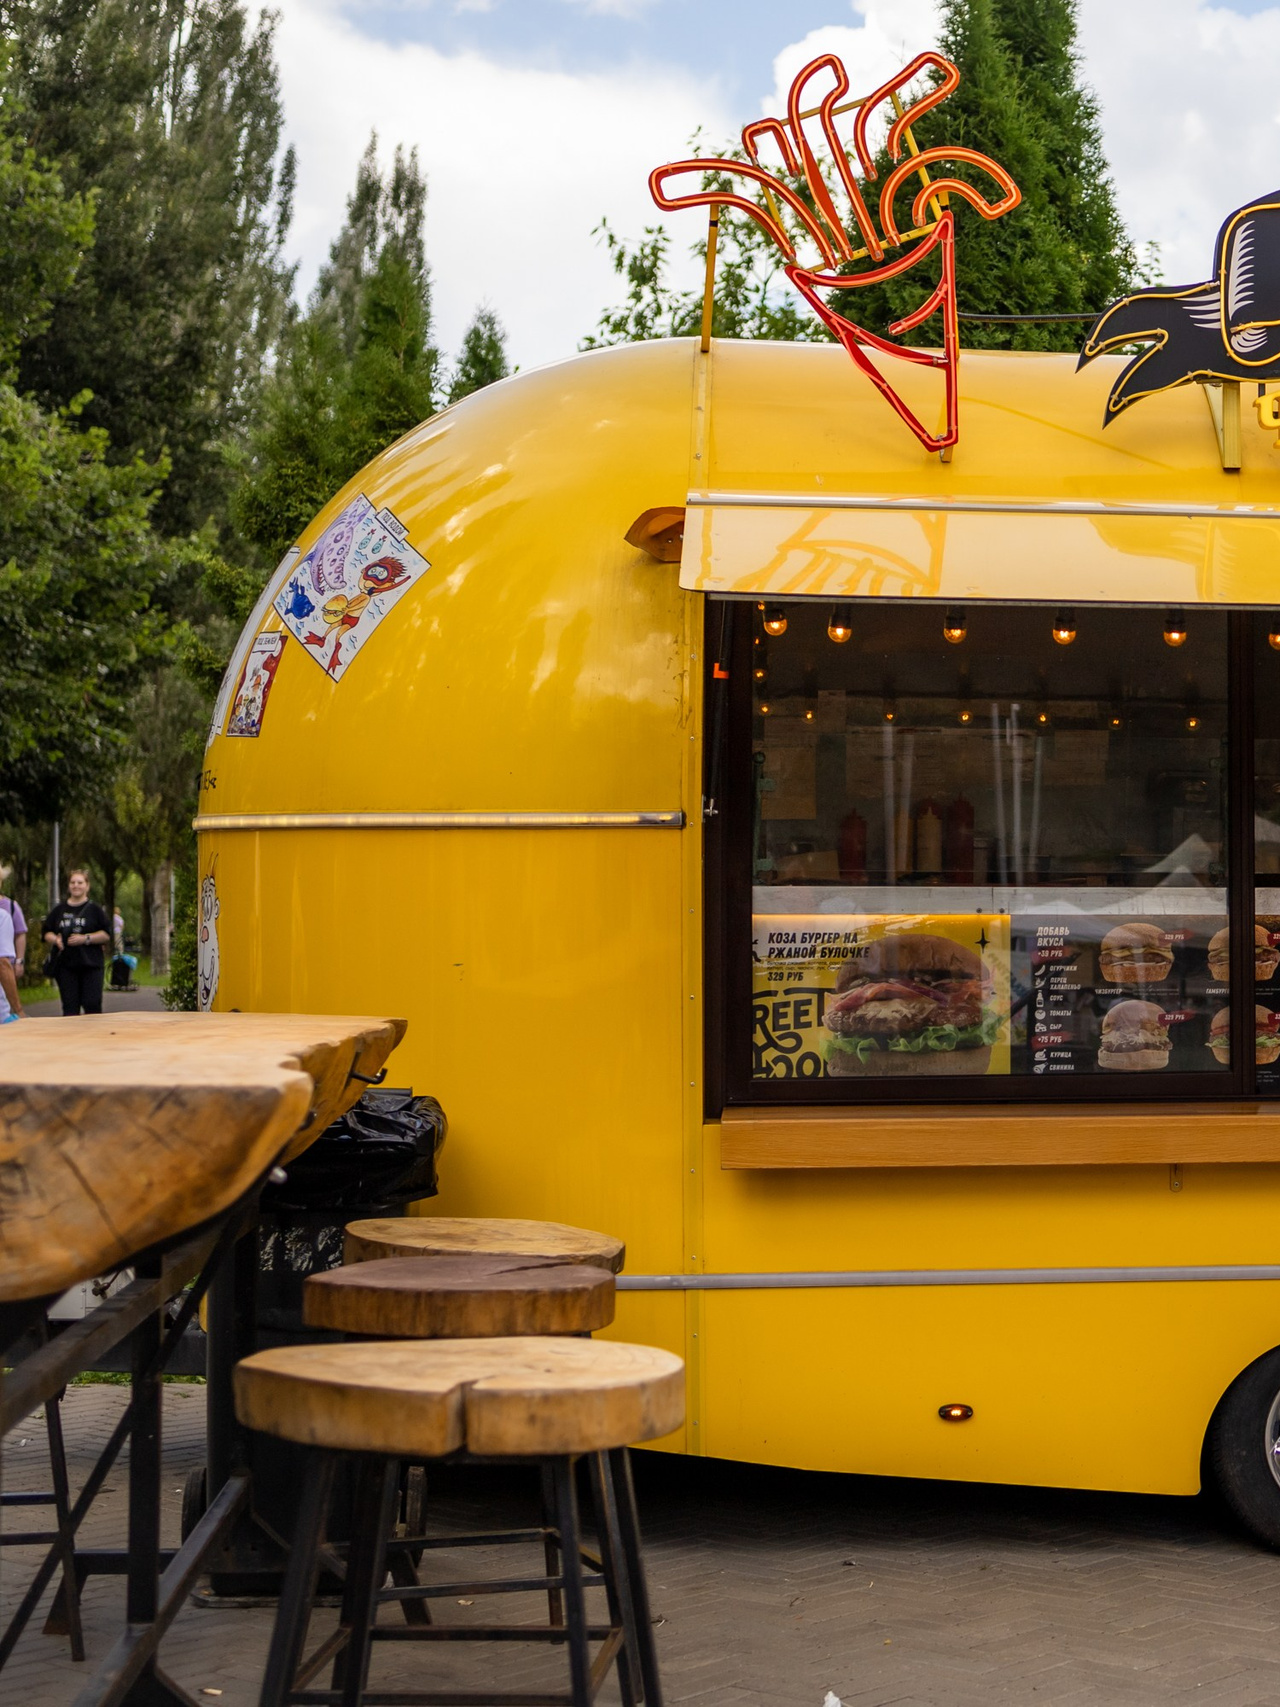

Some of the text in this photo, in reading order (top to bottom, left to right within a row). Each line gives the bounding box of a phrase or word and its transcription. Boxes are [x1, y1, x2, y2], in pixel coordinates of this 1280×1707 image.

[1036, 926, 1070, 937] ДОБАВЬ
[768, 932, 858, 944] КОЗА БУРГЕР НА
[1037, 938, 1064, 947] ВКУСА
[767, 945, 870, 958] РЖАНОЙ БУЛОЧКЕ
[767, 972, 804, 981] 329 РУБ
[1049, 1035, 1062, 1043] РУБ
